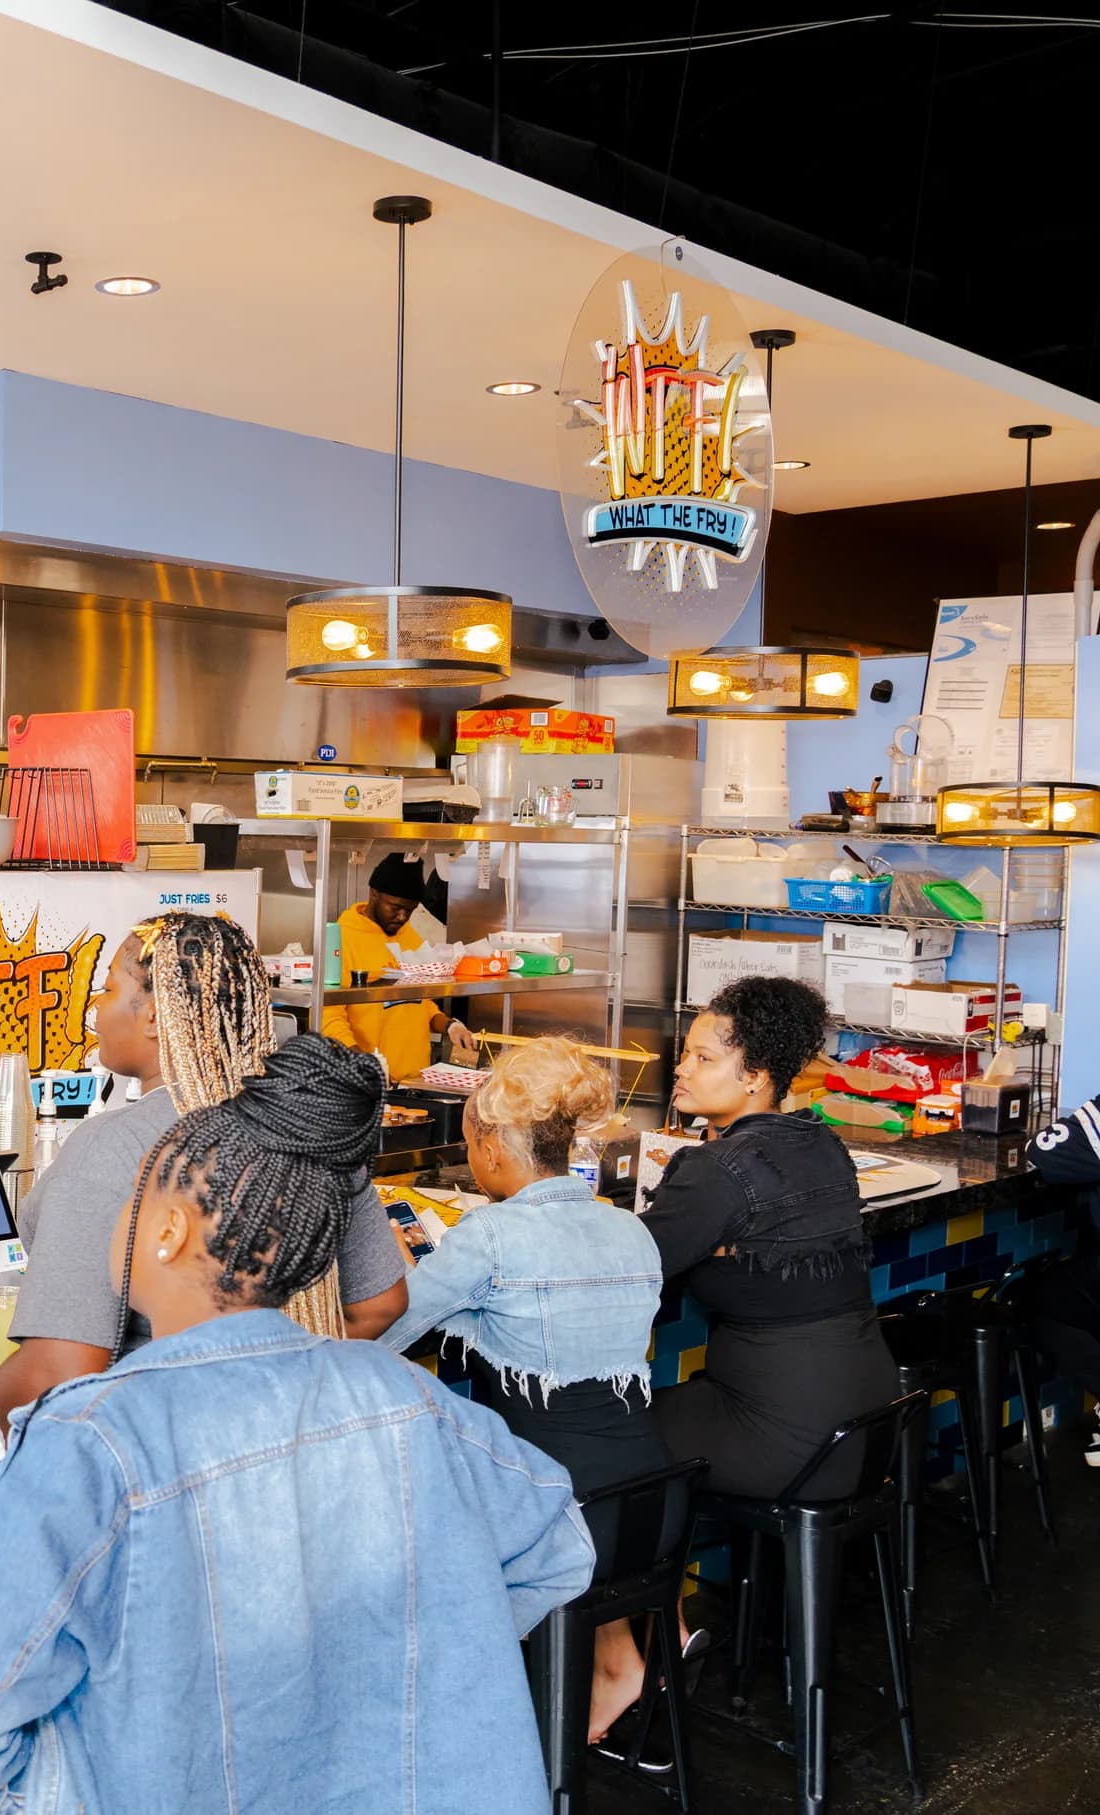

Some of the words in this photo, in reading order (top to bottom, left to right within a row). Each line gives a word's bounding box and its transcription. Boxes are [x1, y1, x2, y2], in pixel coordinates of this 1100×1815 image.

[609, 503, 655, 529] WHAT
[660, 503, 692, 528] THE
[696, 508, 727, 534] FRY
[533, 730, 544, 741] 50
[160, 894, 183, 904] JUST
[186, 894, 210, 904] FRIES
[216, 894, 228, 903] $6
